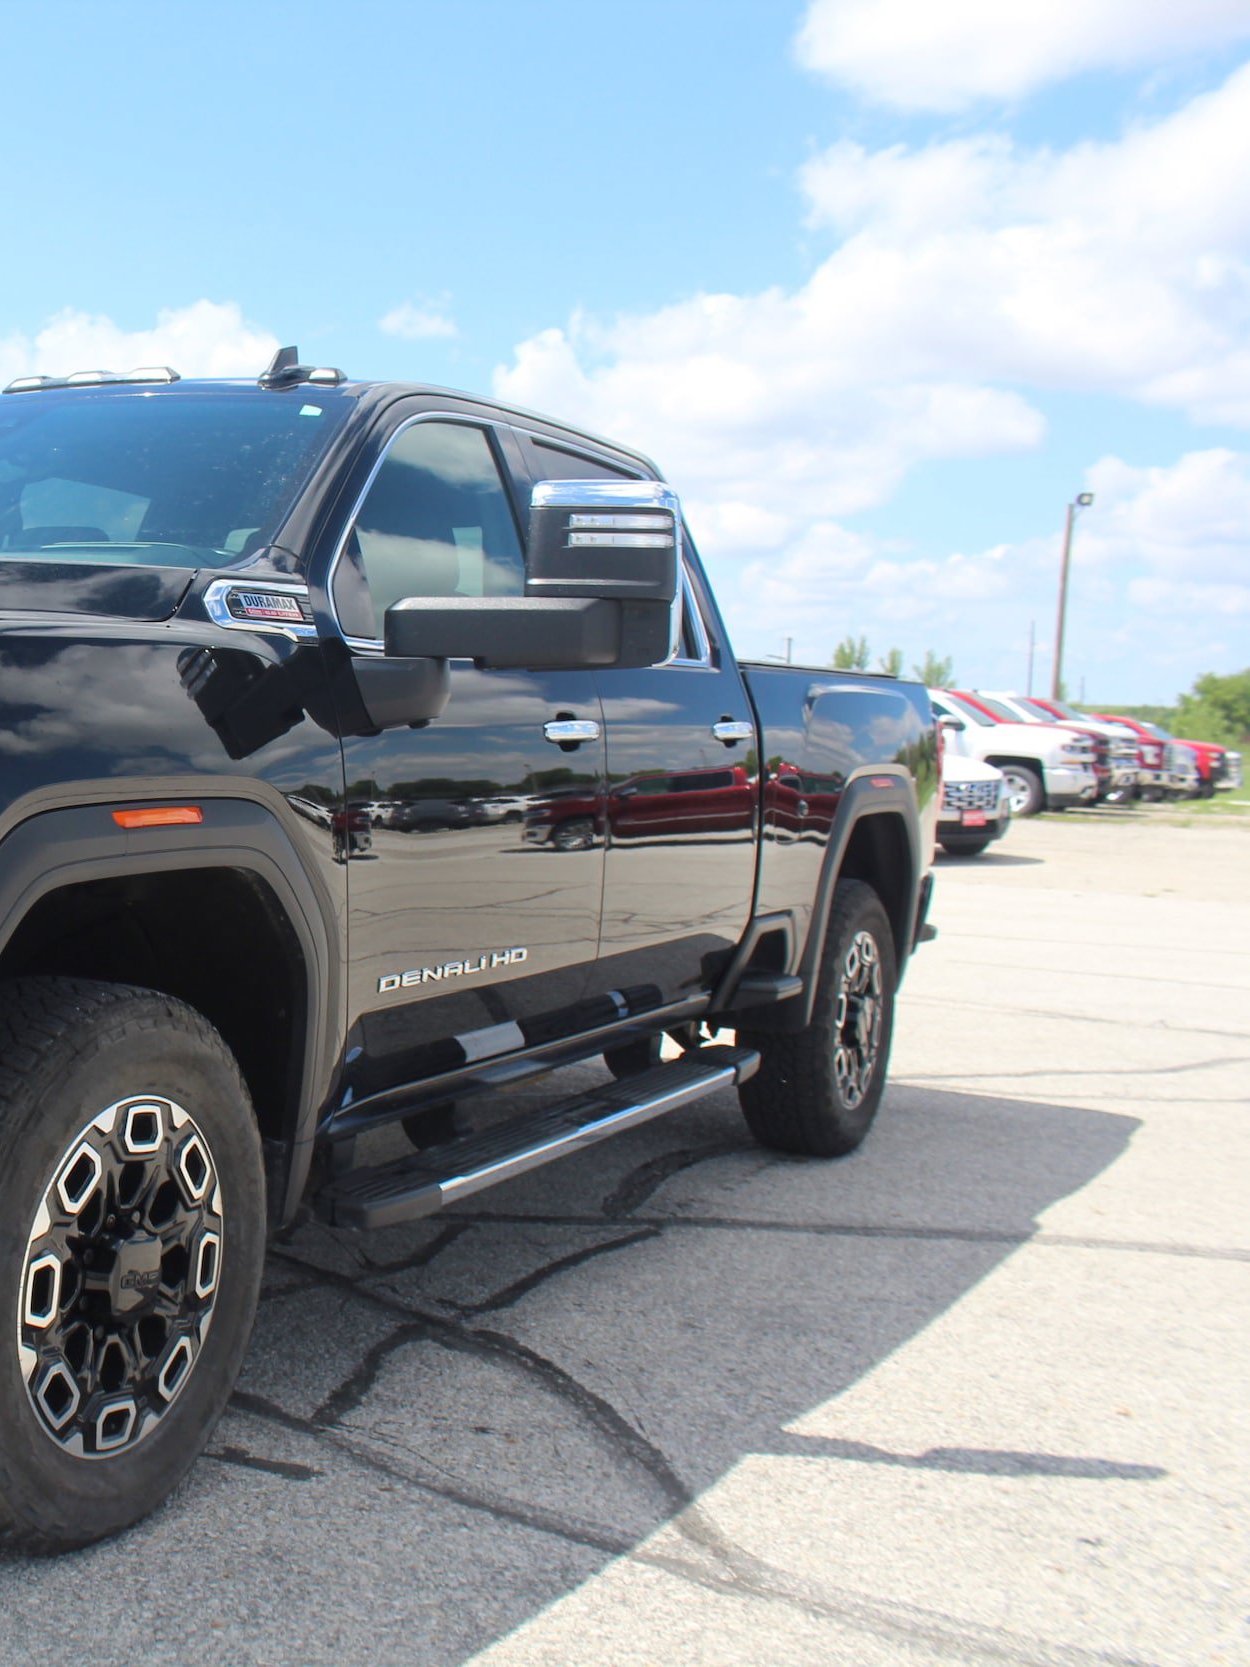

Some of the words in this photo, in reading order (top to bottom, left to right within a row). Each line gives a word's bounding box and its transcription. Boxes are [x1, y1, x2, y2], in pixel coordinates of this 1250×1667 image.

[243, 595, 296, 610] DURAMAX
[378, 956, 486, 993] DENALI
[491, 947, 528, 968] HD
